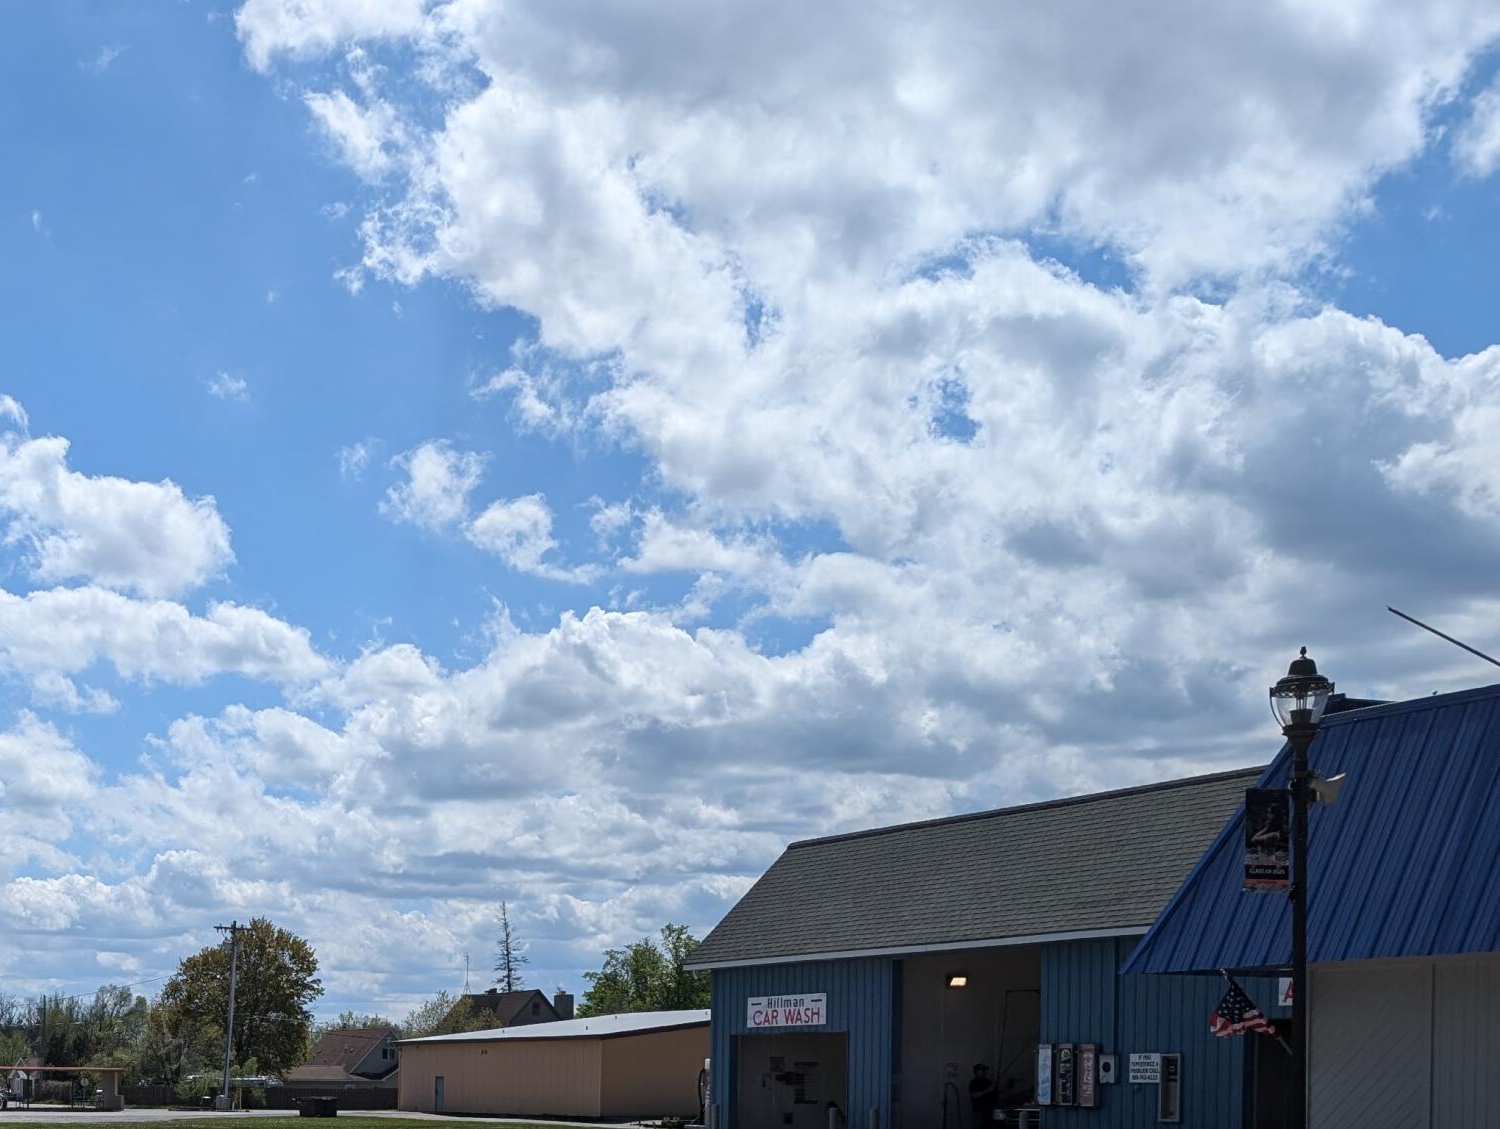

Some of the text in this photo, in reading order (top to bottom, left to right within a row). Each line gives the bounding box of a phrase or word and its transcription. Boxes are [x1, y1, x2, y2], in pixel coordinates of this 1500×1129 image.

[767, 997, 805, 1009] Hillman
[753, 1007, 820, 1025] CAR WASH
